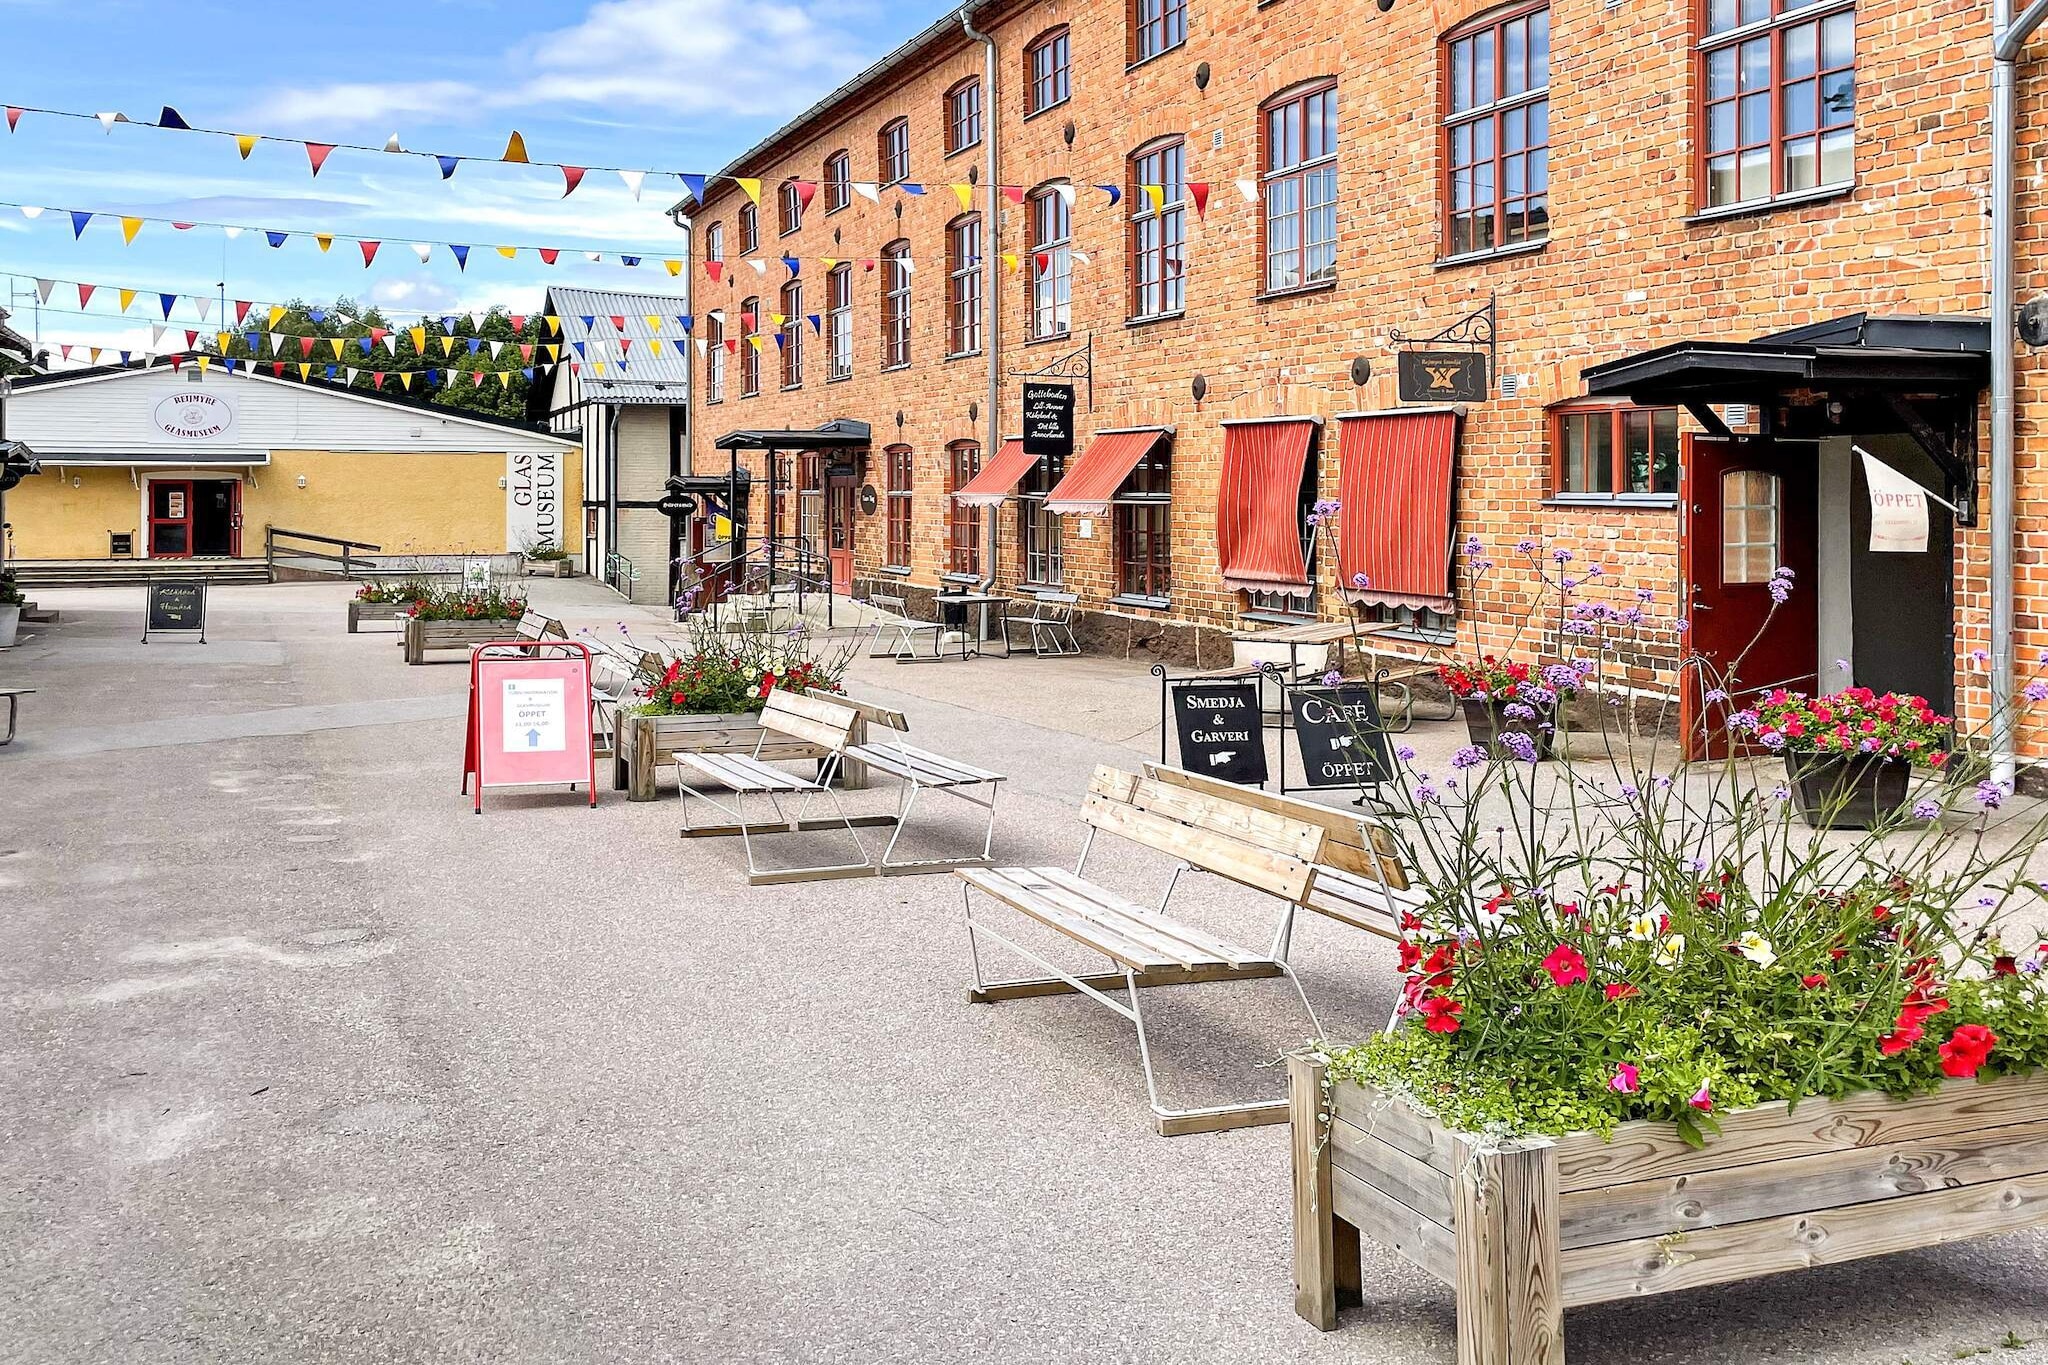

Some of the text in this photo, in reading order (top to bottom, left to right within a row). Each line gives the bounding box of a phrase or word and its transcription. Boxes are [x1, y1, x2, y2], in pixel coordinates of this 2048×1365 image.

[173, 395, 217, 406] REIJMYRE
[164, 424, 221, 437] GLASMUSEUM
[513, 454, 532, 507] GLAS
[536, 452, 555, 549] MUSEUM
[1873, 489, 1922, 508] ÖPPET
[1212, 713, 1225, 726] &
[1321, 761, 1374, 778] ÖPPET
